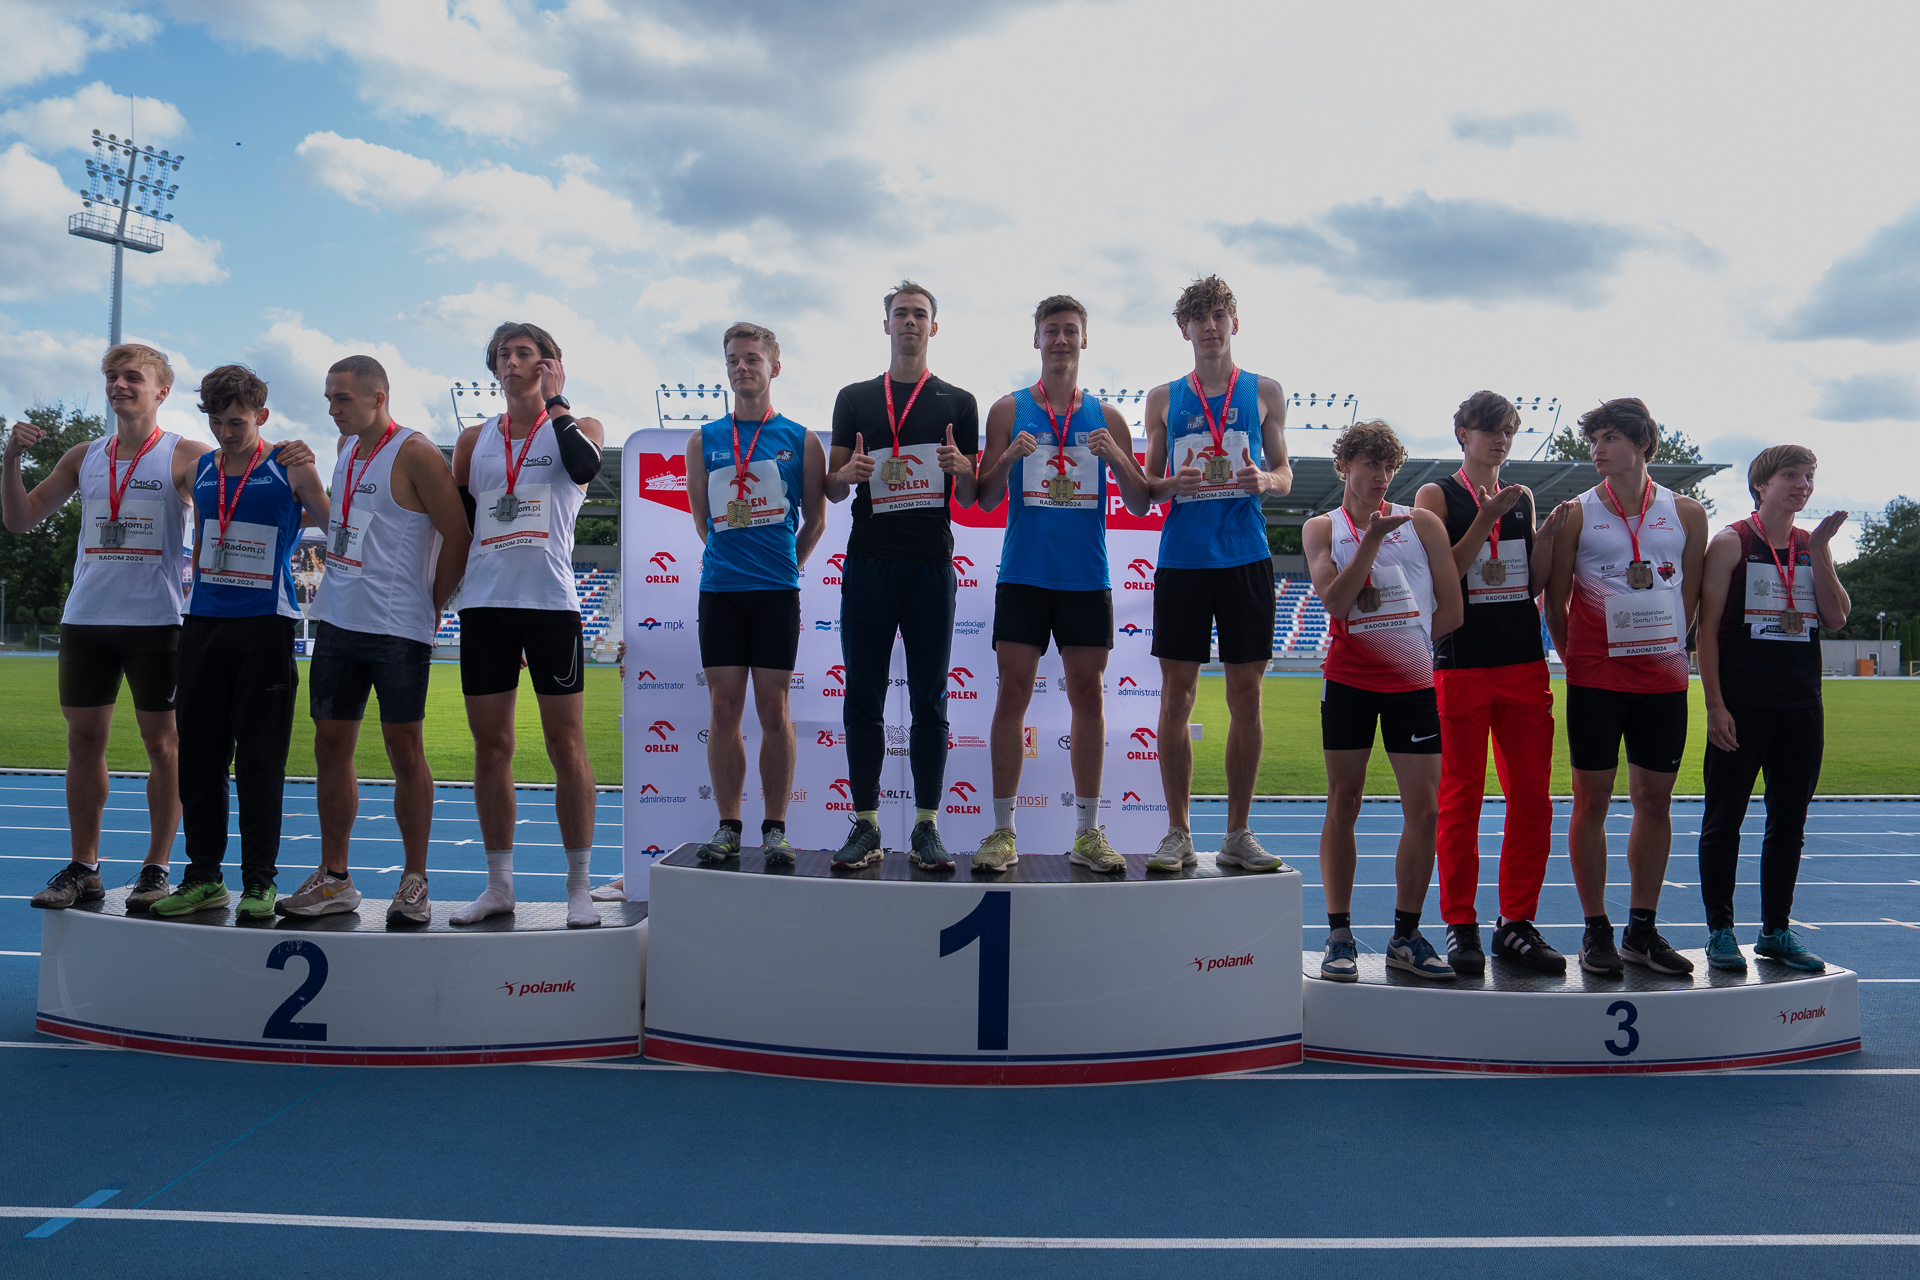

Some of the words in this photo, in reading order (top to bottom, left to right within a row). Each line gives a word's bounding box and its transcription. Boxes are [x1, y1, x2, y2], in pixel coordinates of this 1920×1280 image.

[889, 479, 929, 491] ORLEN
[495, 540, 515, 549] RADOM
[645, 575, 679, 583] ORLEN
[822, 577, 842, 585] ORL
[958, 579, 977, 587] LEN
[664, 620, 684, 631] mpk
[823, 689, 846, 697] ORL
[1118, 688, 1161, 696] administrato
[645, 744, 678, 753] ORLEN
[886, 748, 909, 756] Nestl
[789, 789, 807, 800] osir
[1016, 794, 1048, 806] mosir
[946, 806, 980, 814] ORLEN
[1122, 803, 1168, 811] administrato
[1206, 953, 1254, 972] polanik
[939, 891, 1011, 1050] 1
[262, 940, 328, 1041] 2
[518, 980, 576, 997] polanik
[1790, 1006, 1826, 1024] polanik
[1604, 1000, 1639, 1056] 3
